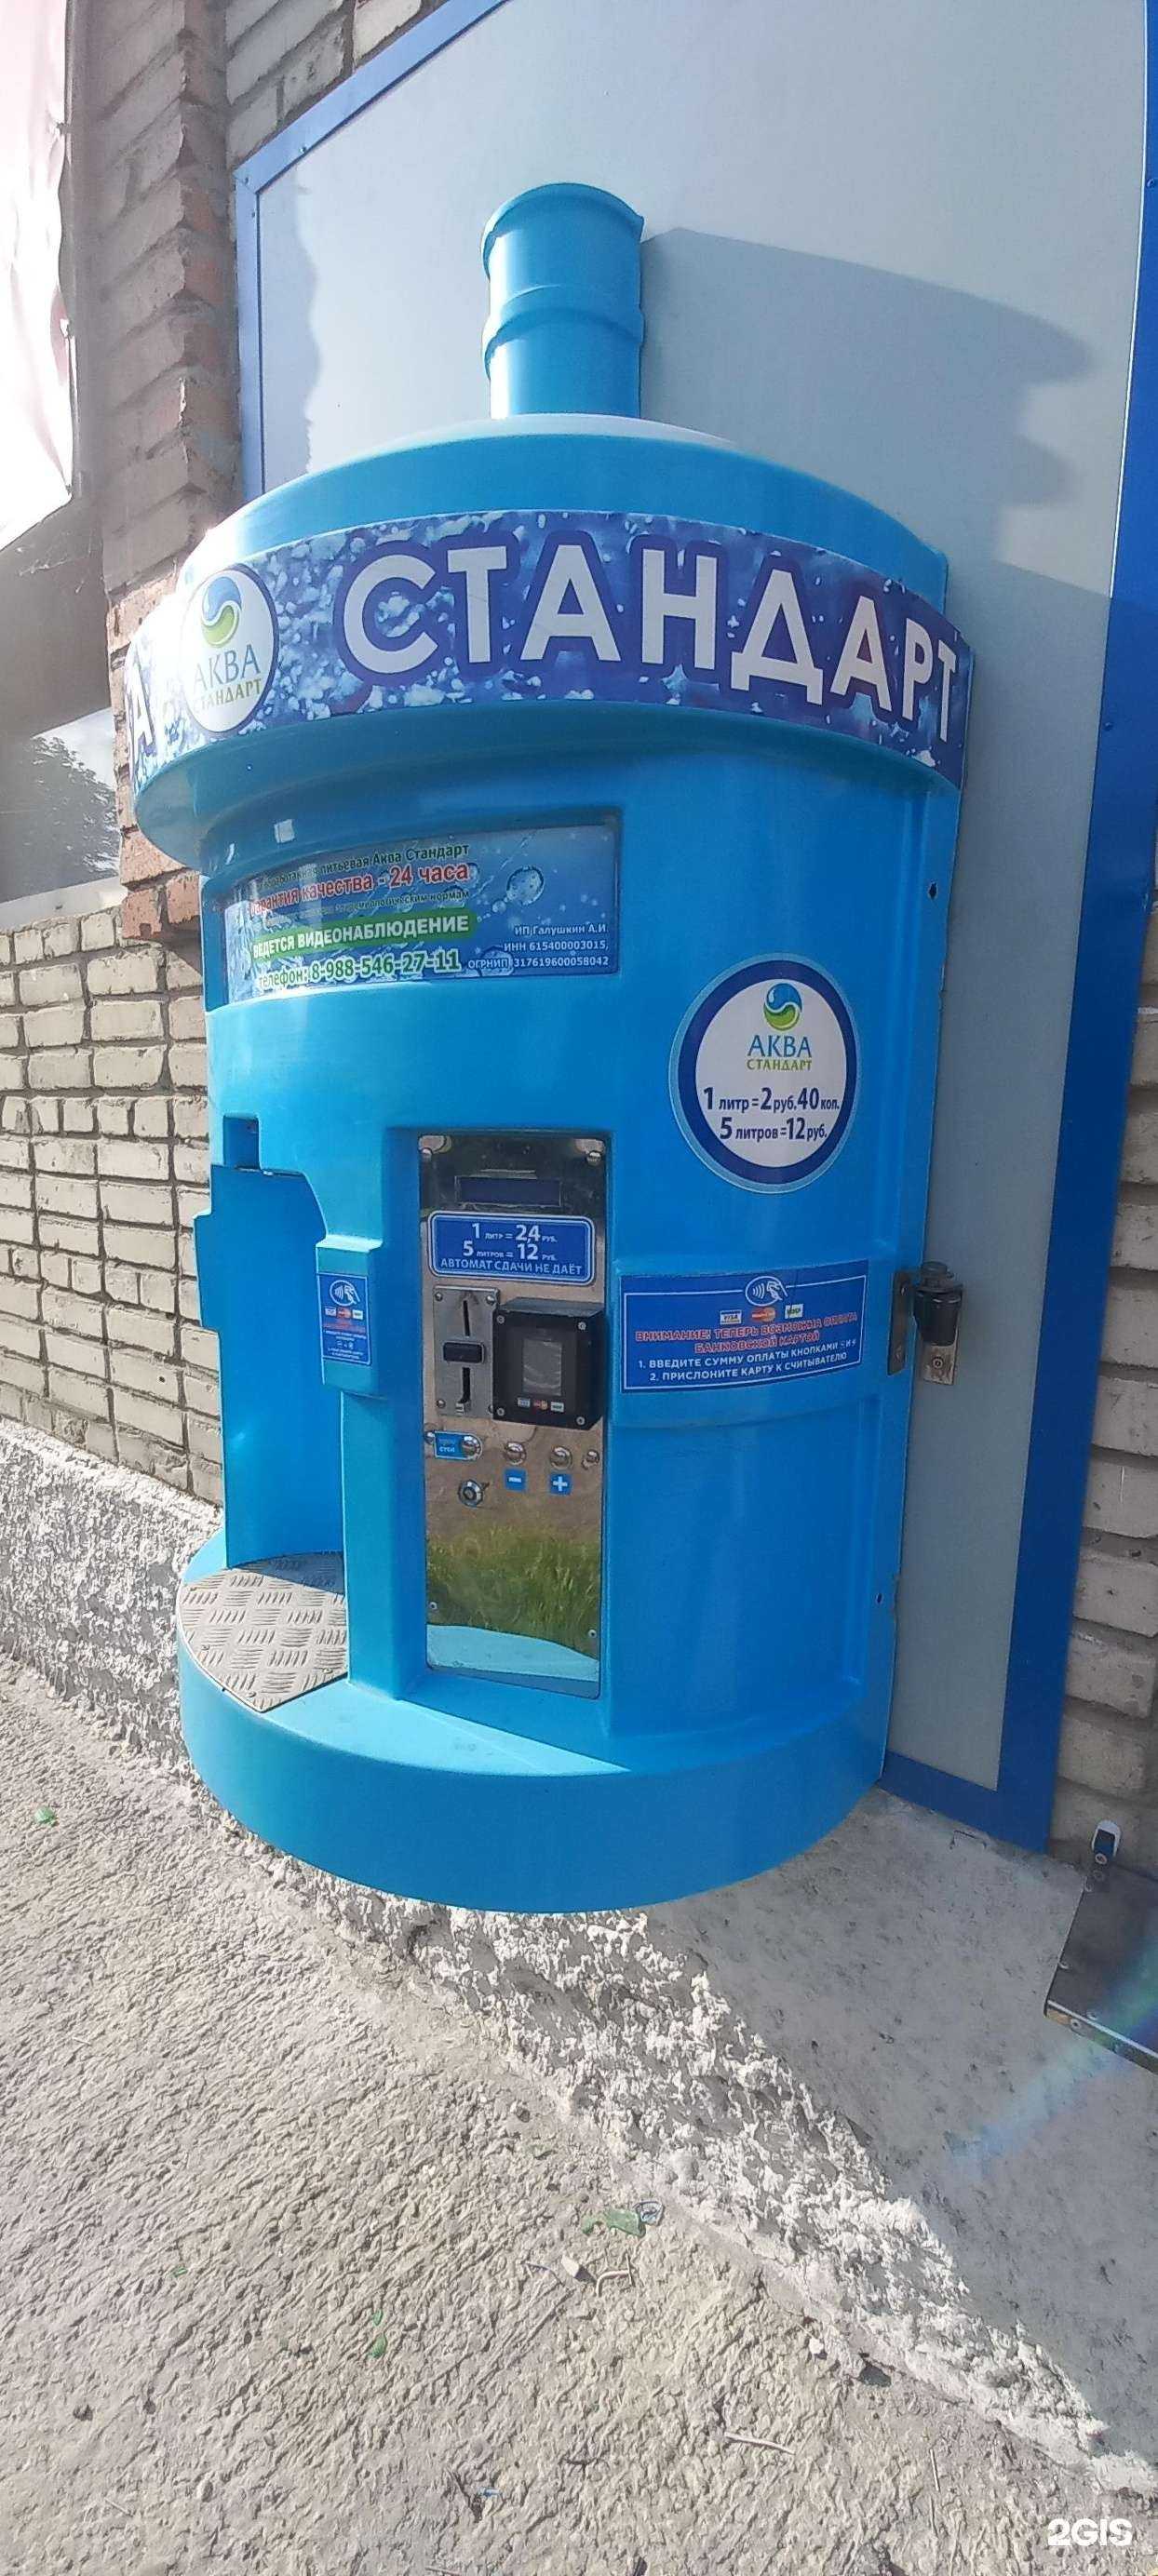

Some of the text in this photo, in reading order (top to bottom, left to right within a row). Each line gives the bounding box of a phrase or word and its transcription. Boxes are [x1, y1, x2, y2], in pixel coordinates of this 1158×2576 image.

[343, 544, 957, 743] СТАНДАРТ
[194, 644, 261, 691] АКВА
[373, 852, 401, 865] Аква
[406, 845, 469, 861] Стандарт
[300, 874, 373, 901] качества
[390, 865, 413, 888] 24
[419, 864, 469, 883] часа
[253, 916, 469, 959] ВЕДЕТСЯ ВИДЕОНАБЛЮДЕНИЕ
[514, 926, 530, 935] ИП
[532, 925, 586, 936] Галушкин
[504, 943, 526, 951] ИНН
[311, 949, 462, 982] 8-988-546-27-11
[468, 959, 508, 969] ОГРНИП
[747, 1035, 812, 1058] АКВА
[747, 1059, 812, 1071] СТАНДАРТ
[703, 1087, 713, 1110] 1
[719, 1096, 749, 1113] литр
[720, 1118, 733, 1140] 5
[735, 1126, 778, 1142] литров
[472, 1223, 480, 1239] 1
[463, 1241, 474, 1256] 5
[518, 1243, 538, 1260] 12
[441, 1258, 582, 1275] АВТОМАТ СДАЧИ НЕ ДАЁТ
[636, 1329, 711, 1341] ВНИМАНИЕ!
[715, 1325, 759, 1339] ТЕПЕРЬ
[694, 1335, 777, 1353] БАНКОВСКОЙ
[649, 1359, 701, 1369] ВВЕДИТЕ
[705, 1355, 744, 1366] СУММУ
[747, 1350, 788, 1362] ОПЛАТЫ
[791, 1342, 838, 1357] КНОПКАМИ
[662, 1368, 738, 1380] ПРИСЛОНИТЕ
[741, 1364, 774, 1376] КАРТУ
[776, 1363, 782, 1372] К
[785, 1351, 847, 1370] СЧИТЫВАТЕЛЮ
